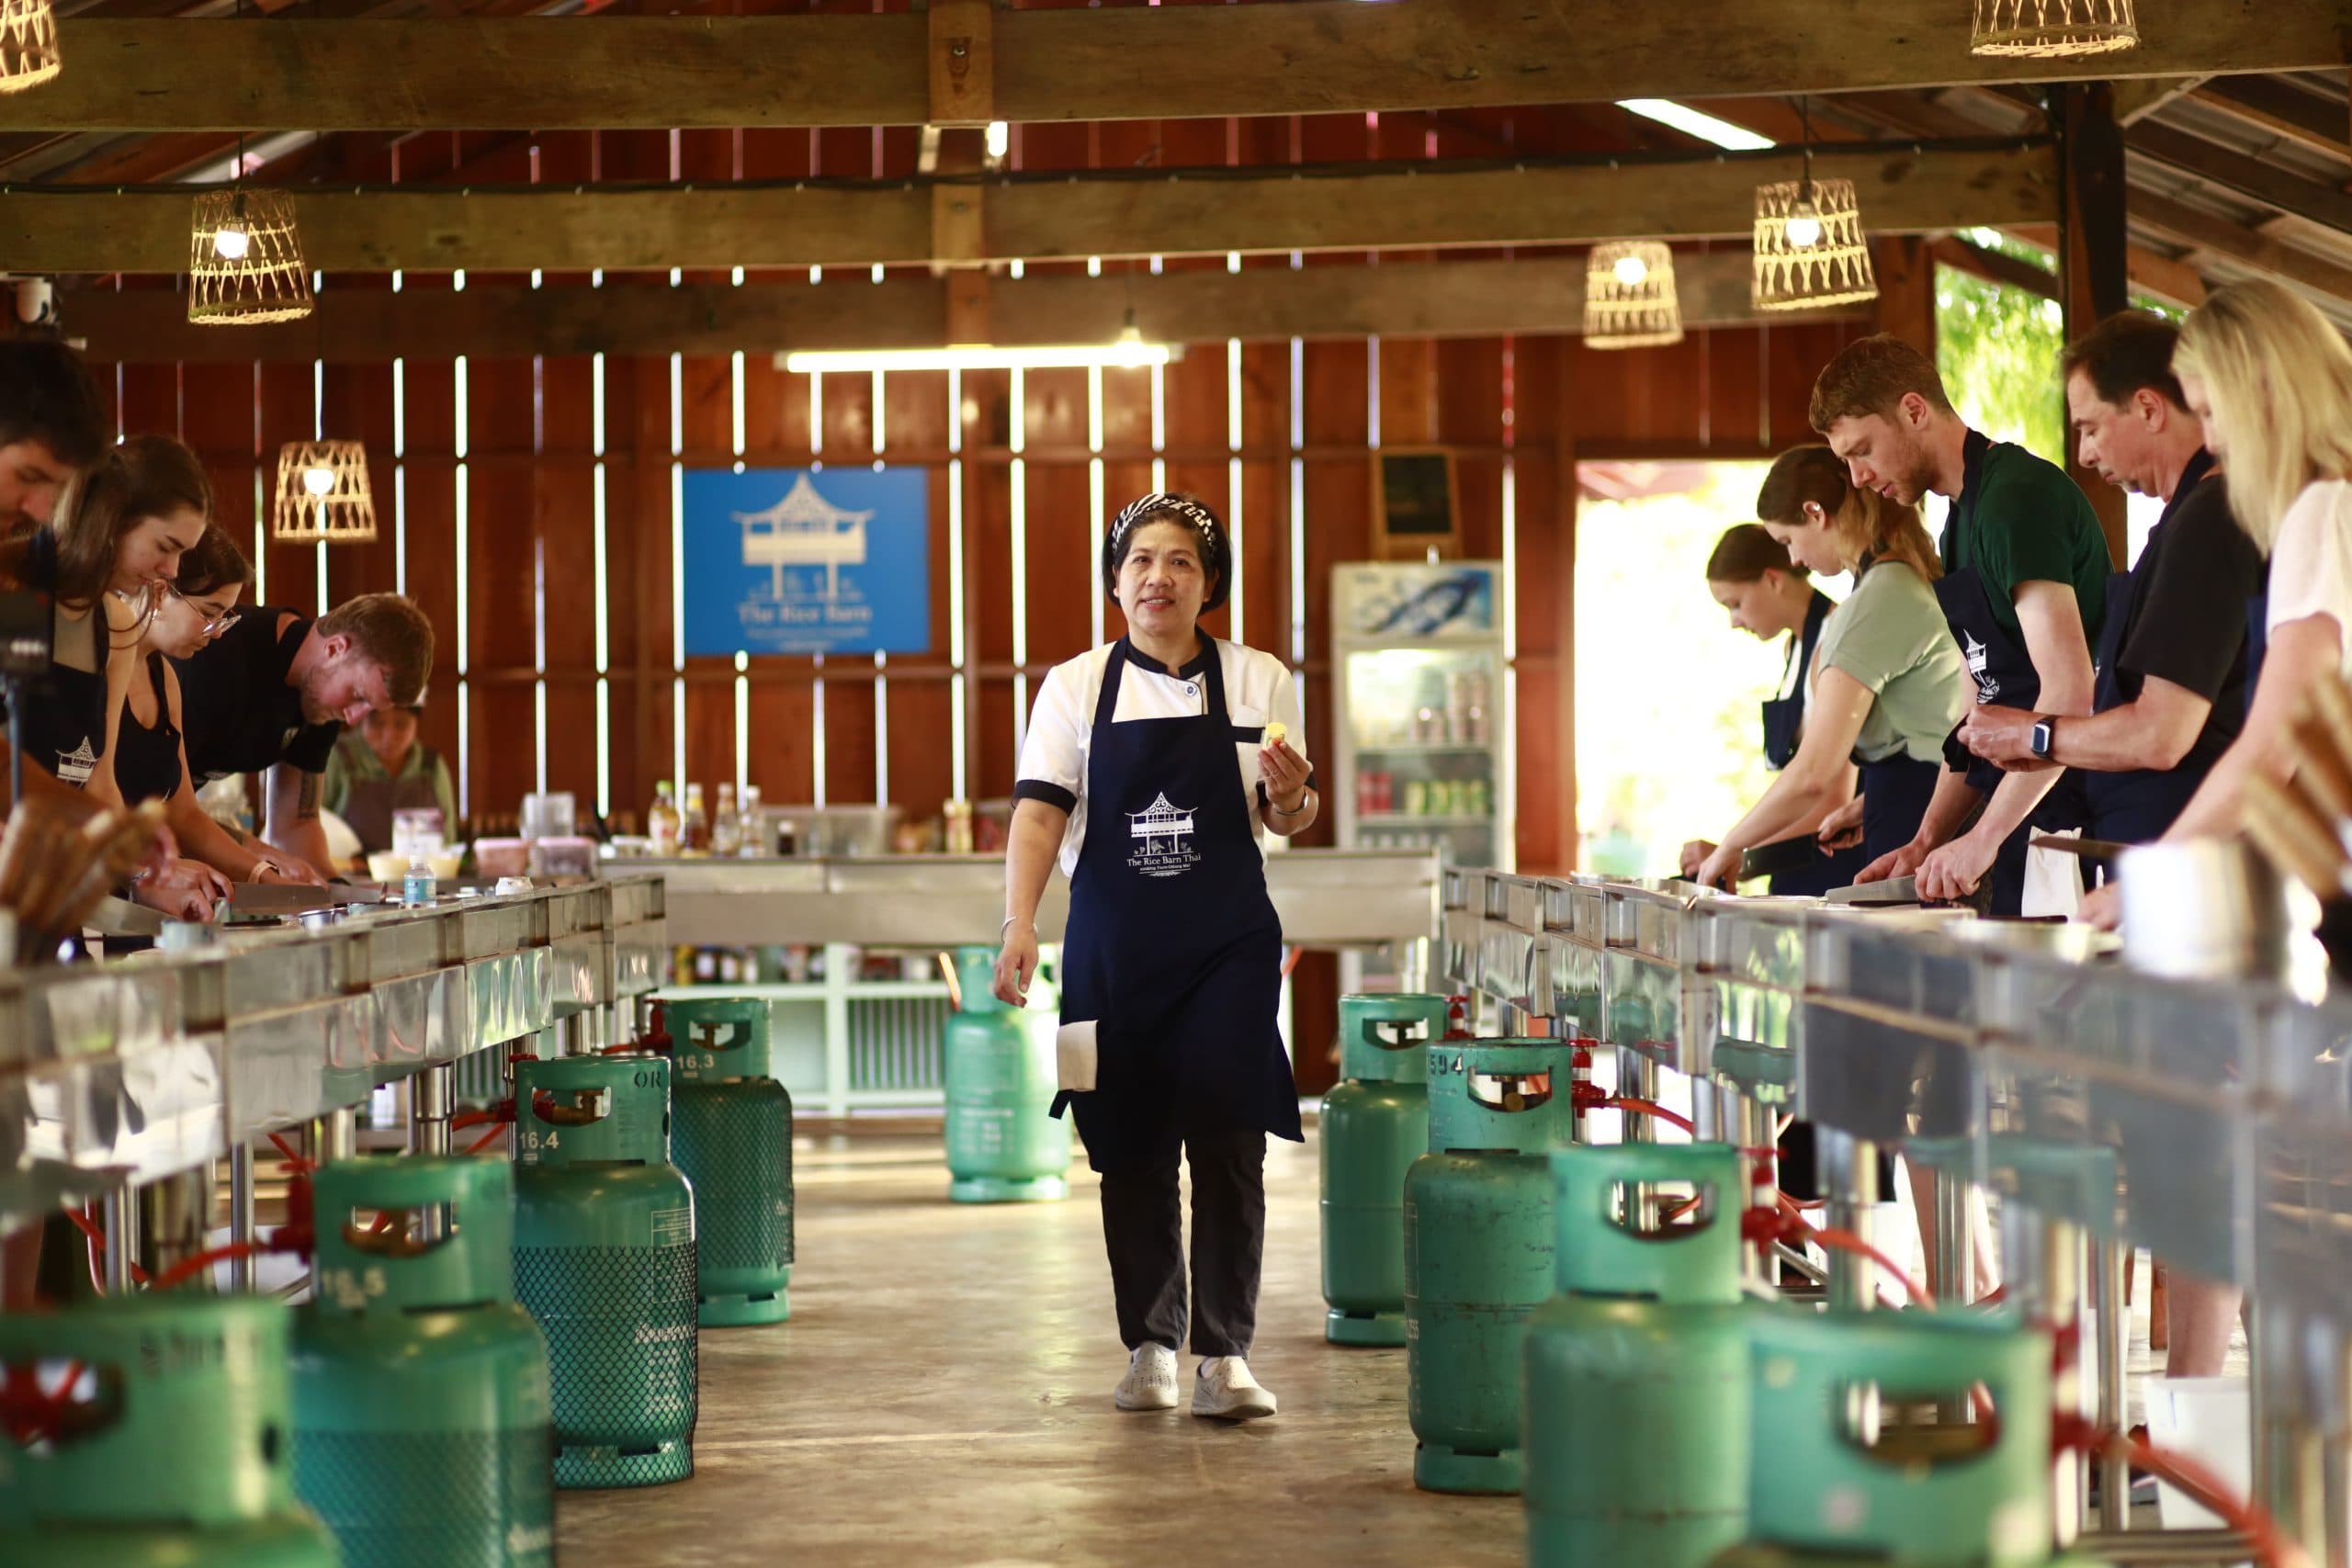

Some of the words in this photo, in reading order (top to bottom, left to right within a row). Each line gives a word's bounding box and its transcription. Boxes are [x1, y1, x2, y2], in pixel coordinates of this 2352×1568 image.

[1126, 858, 1142, 866] The
[1143, 857, 1160, 865] Rice
[1183, 853, 1202, 863] Thai
[676, 1054, 714, 1070] 16.3
[634, 1071, 662, 1088] OR
[520, 1131, 560, 1149] 16.4
